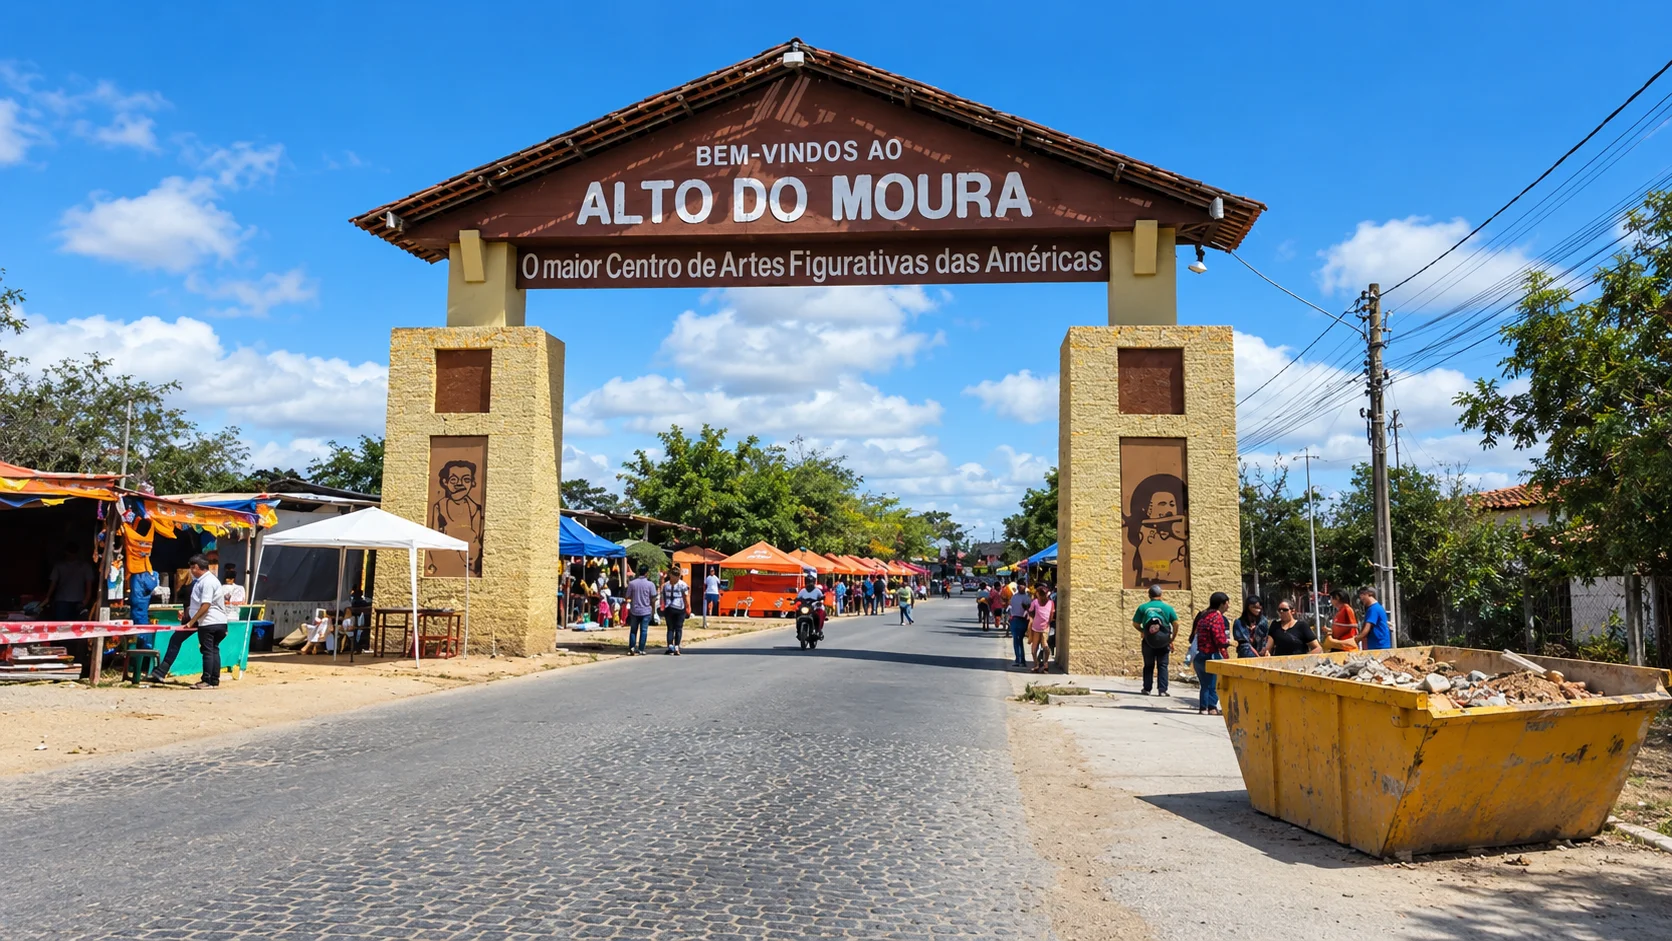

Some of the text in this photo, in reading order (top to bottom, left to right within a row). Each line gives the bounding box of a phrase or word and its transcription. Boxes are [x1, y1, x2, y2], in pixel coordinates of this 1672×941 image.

[696, 138, 903, 167] BEM-VINDOS AO
[576, 171, 1034, 226] ALTO DO MOURA
[522, 244, 1102, 283] O maior Centro de Artes Figurativas das Américas
